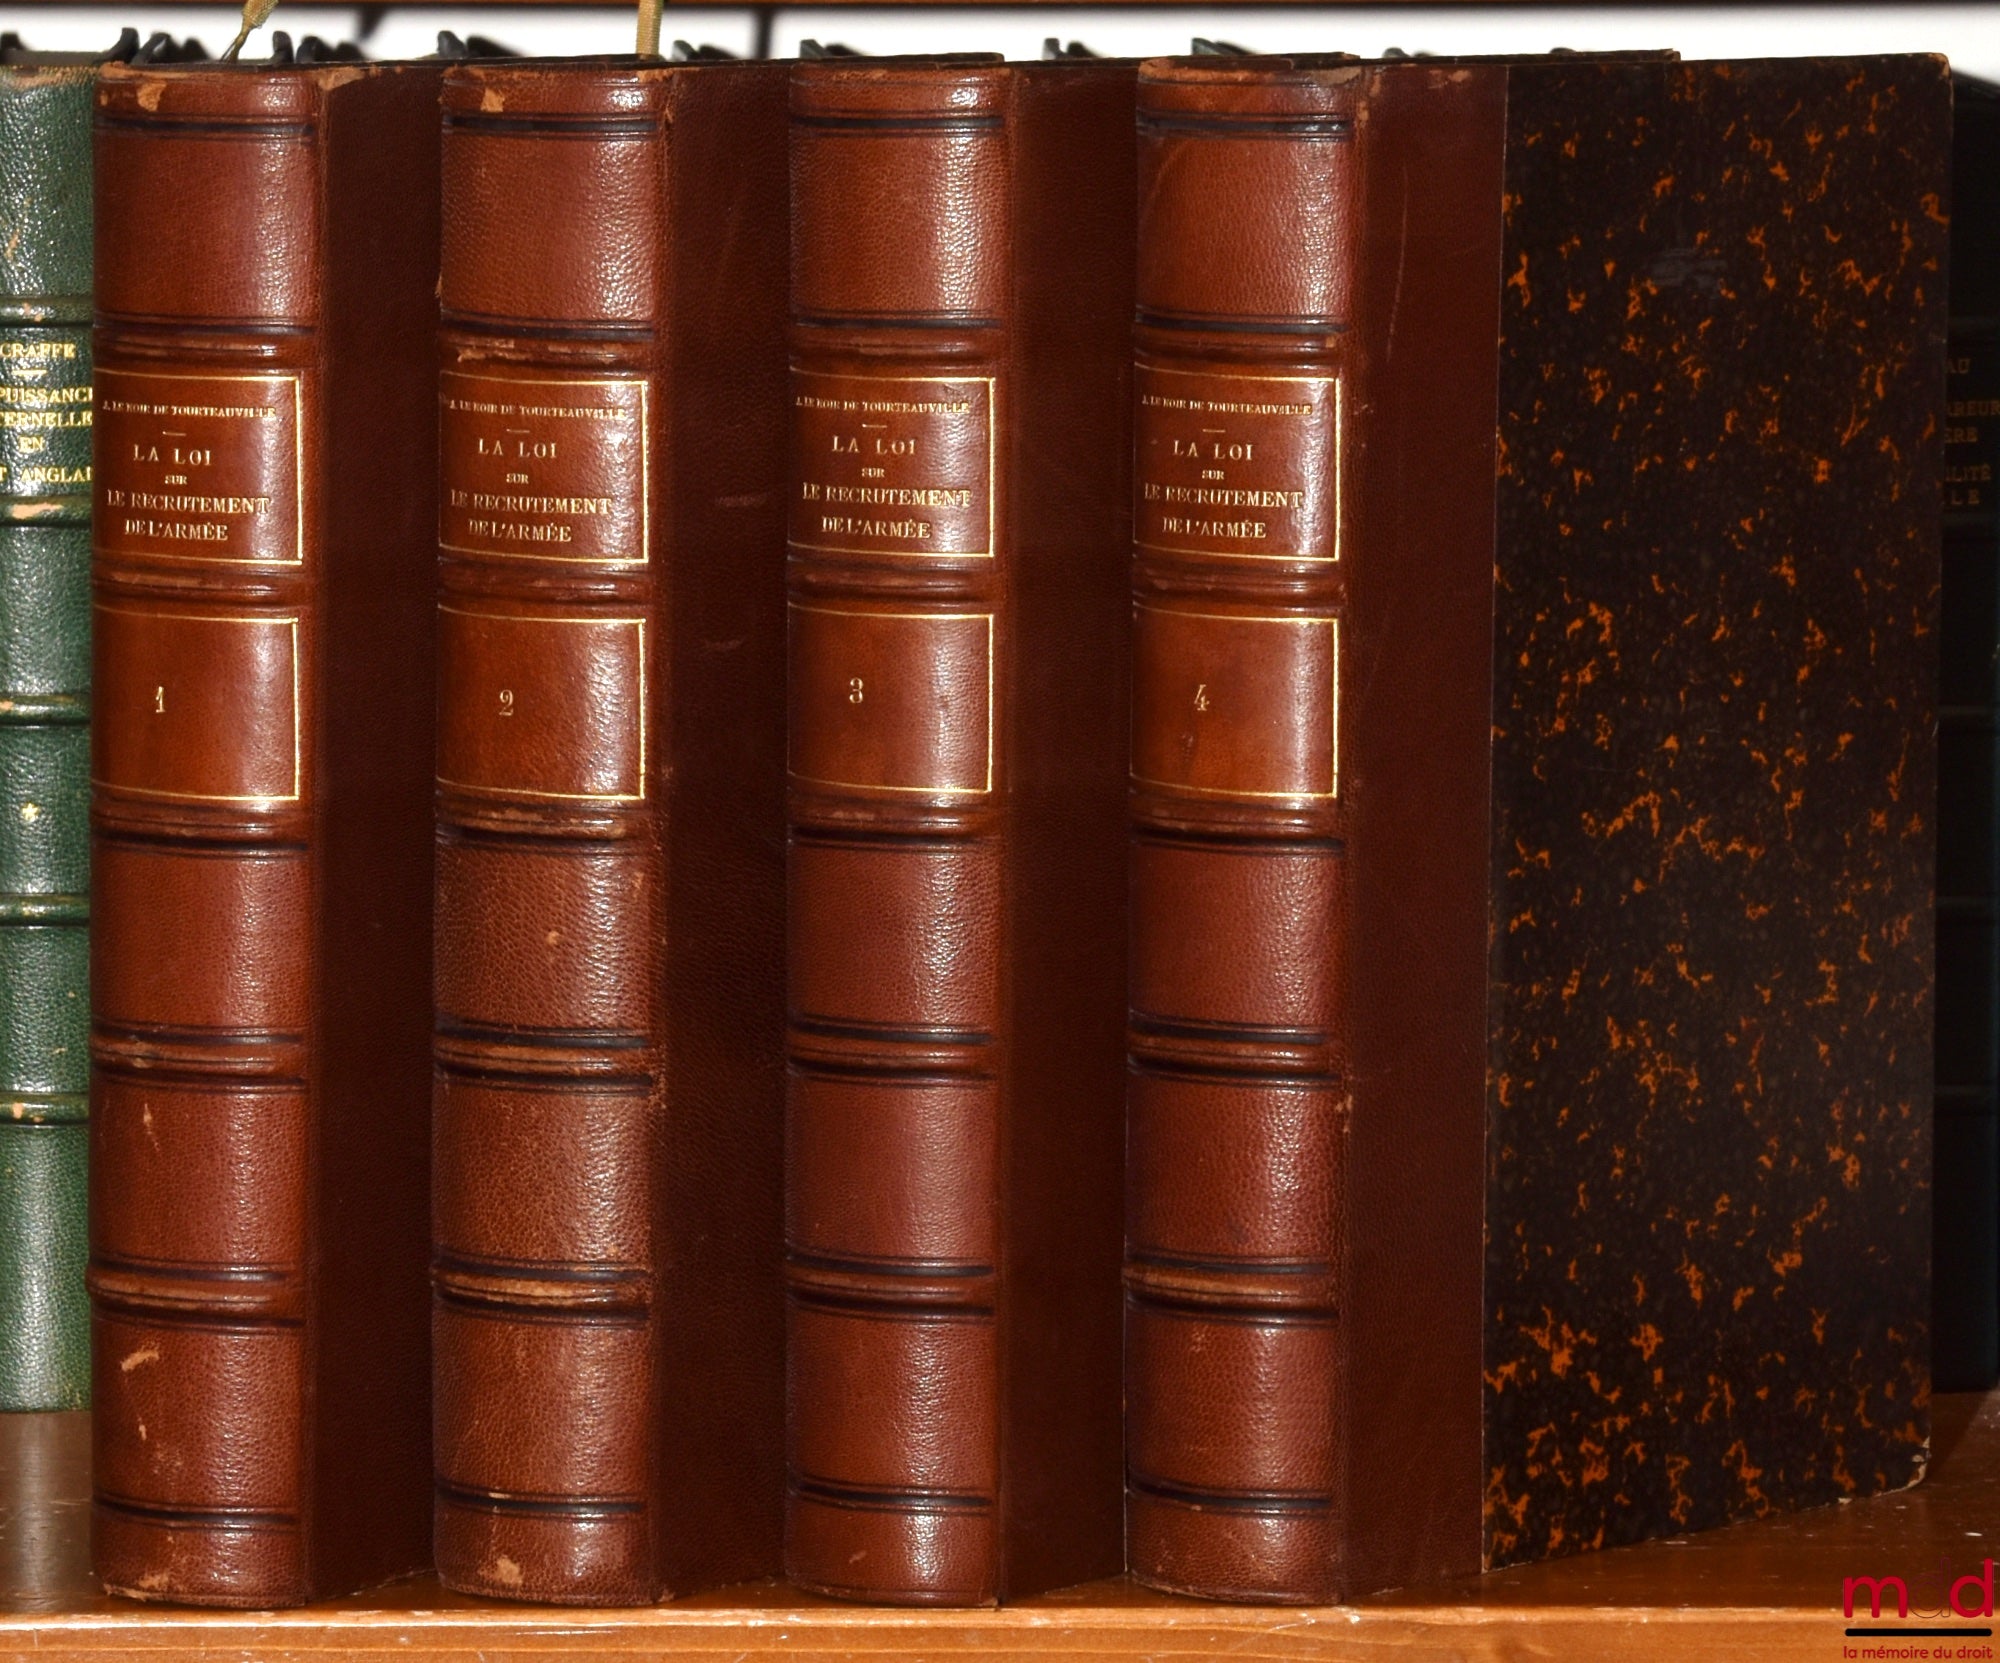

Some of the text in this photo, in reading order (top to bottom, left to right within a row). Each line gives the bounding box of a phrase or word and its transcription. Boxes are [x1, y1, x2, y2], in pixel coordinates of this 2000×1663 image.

[19, 436, 45, 453] EN
[133, 444, 212, 466] LA LOI
[478, 438, 557, 459] LA LOI
[832, 435, 916, 455] LA LOI
[1173, 439, 1253, 461] LA LOI
[165, 475, 188, 485] SUR
[506, 473, 529, 484] SUR
[861, 468, 885, 478] SUR
[1202, 469, 1225, 480] SUR
[107, 489, 270, 514] LE RECRUTEMENT
[451, 489, 612, 515] LE RECRUTEMENT
[803, 482, 972, 507] LE RECRUTEMENT
[1145, 482, 1303, 508] LE RECRUTEMENT
[155, 686, 166, 713] 1
[849, 677, 864, 704] 3
[1193, 684, 1210, 711] 4
[498, 689, 514, 716] 2
